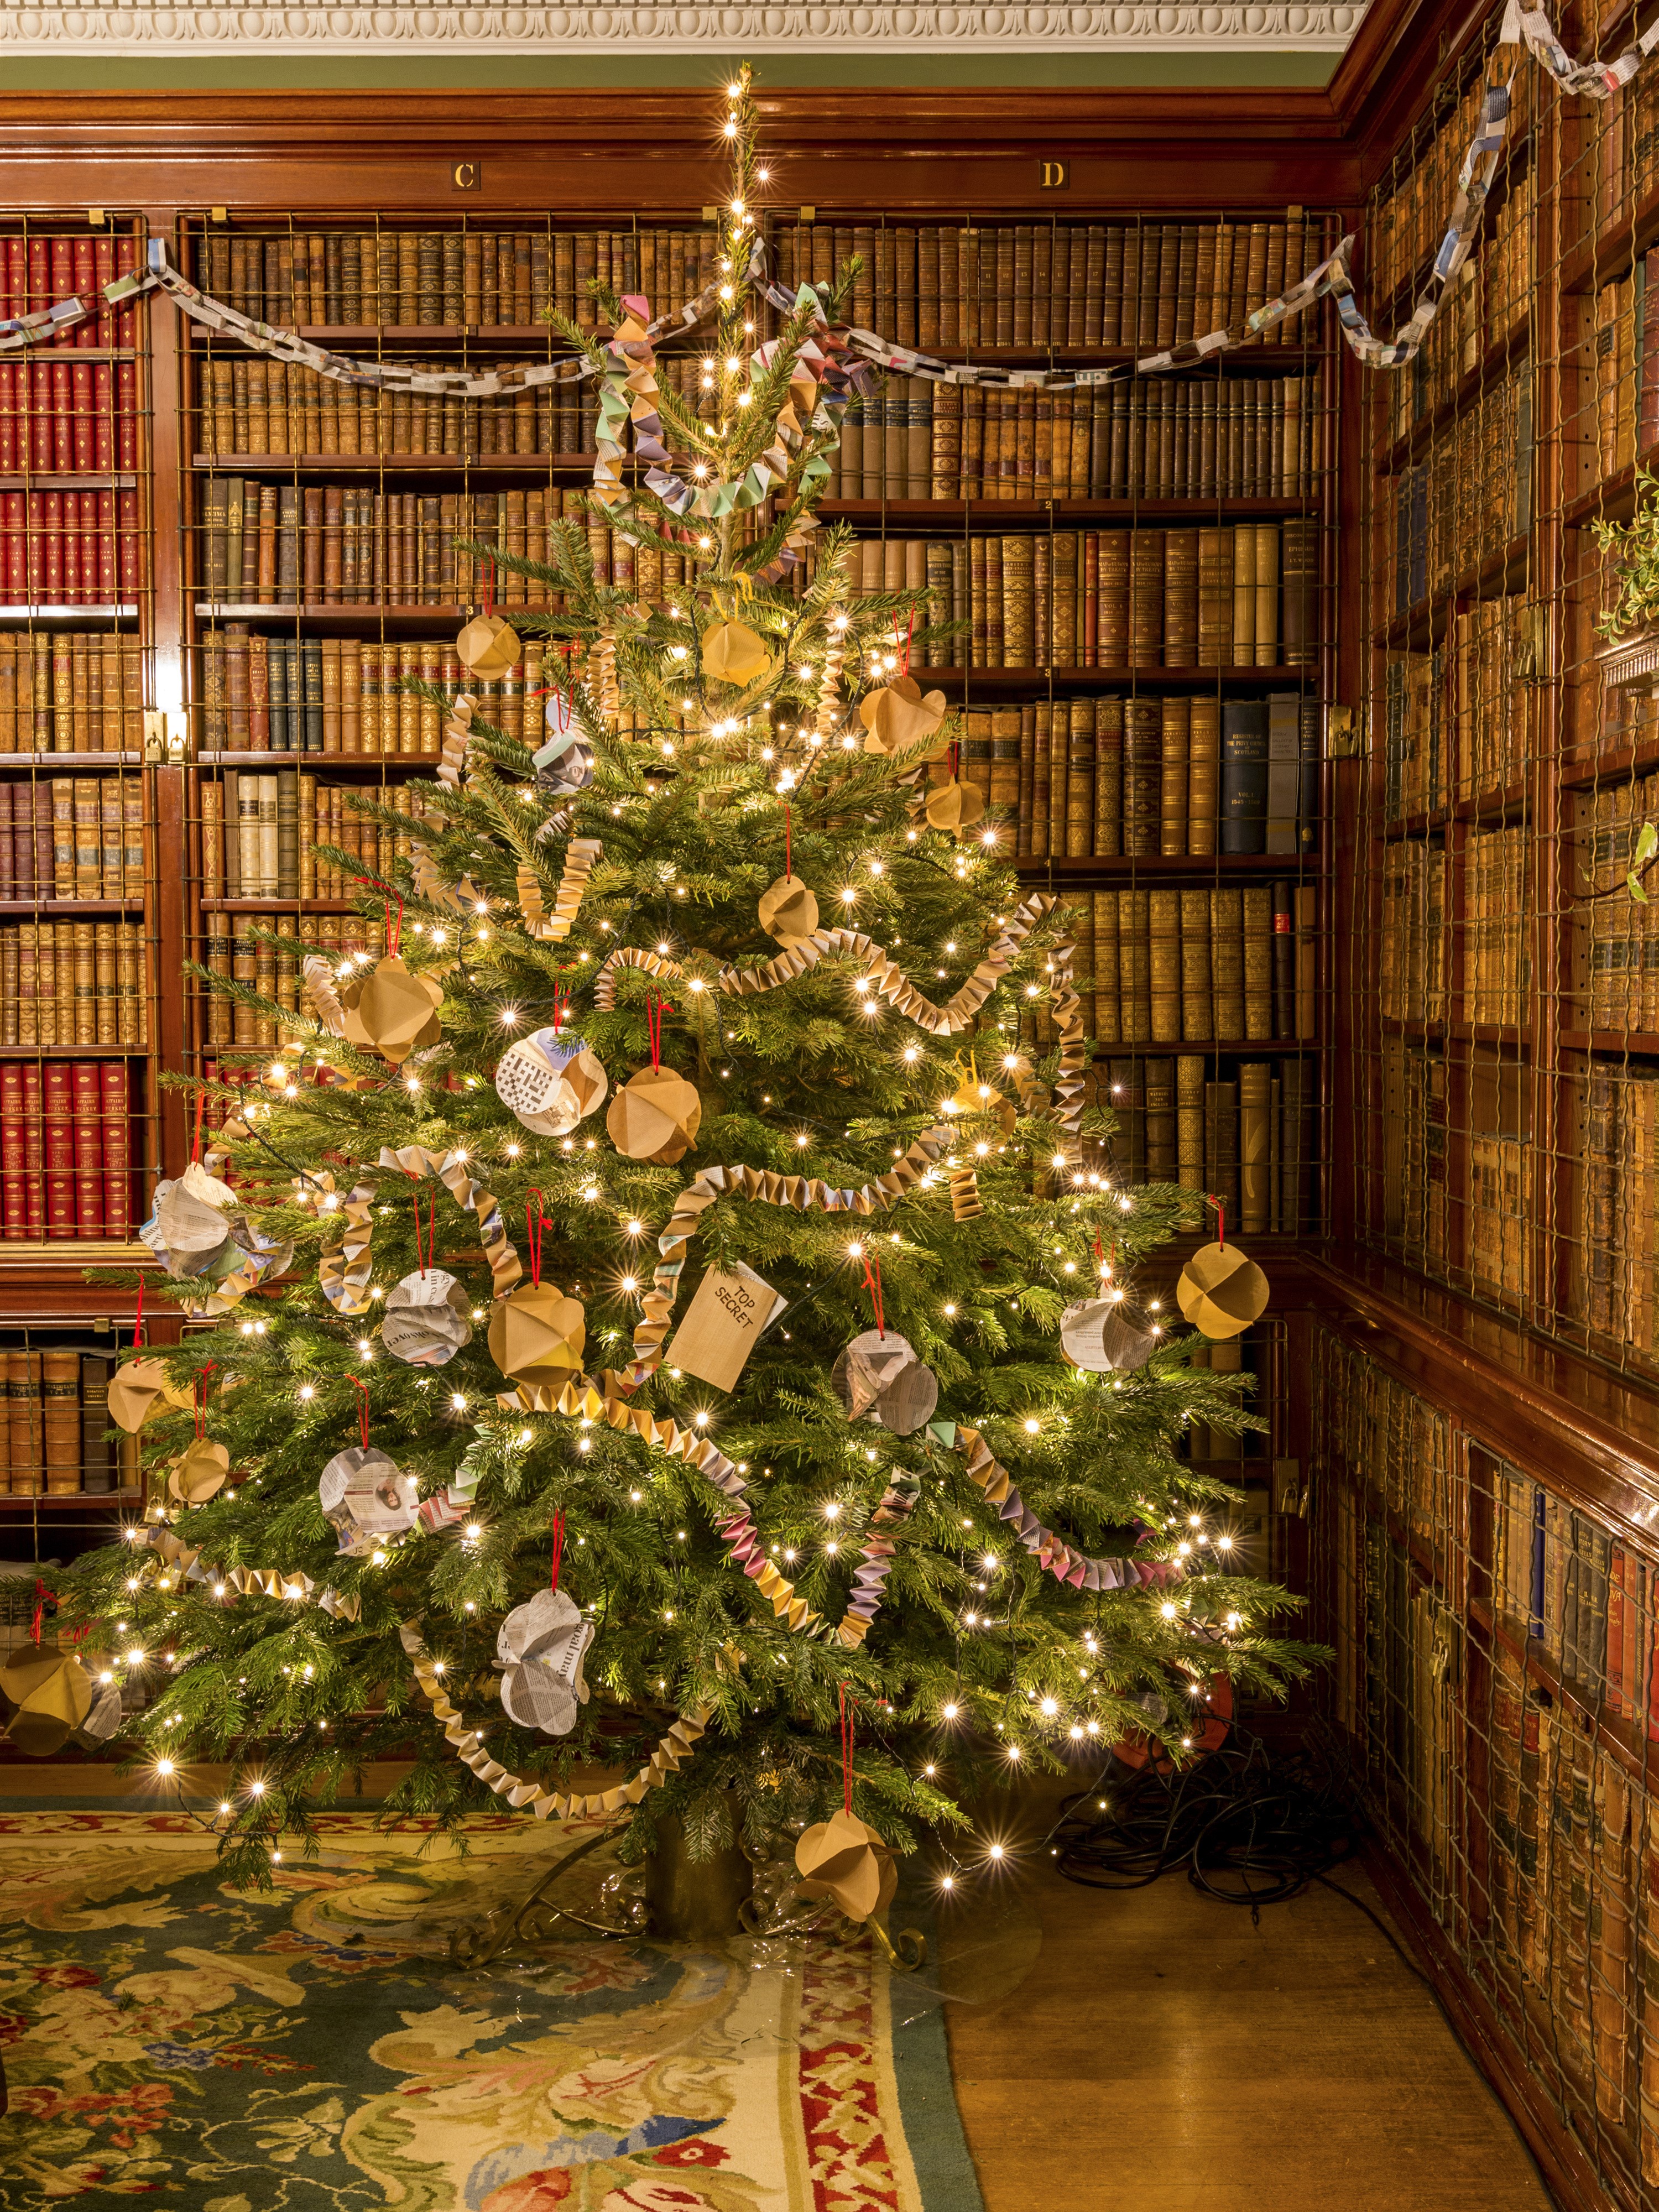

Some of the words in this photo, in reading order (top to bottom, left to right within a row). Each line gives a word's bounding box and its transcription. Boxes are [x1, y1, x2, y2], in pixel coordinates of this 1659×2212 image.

[455, 164, 473, 187] C
[1042, 163, 1063, 186] D
[1045, 500, 1051, 509] 2
[468, 606, 473, 614] 3
[1045, 668, 1050, 677] 3
[1044, 859, 1050, 867] 4
[431, 1275, 440, 1285] in
[734, 1286, 755, 1309] TOP
[714, 1287, 753, 1328] SECRET
[387, 1333, 410, 1348] over
[569, 1623, 585, 1652] goal
[556, 1652, 573, 1677] may
